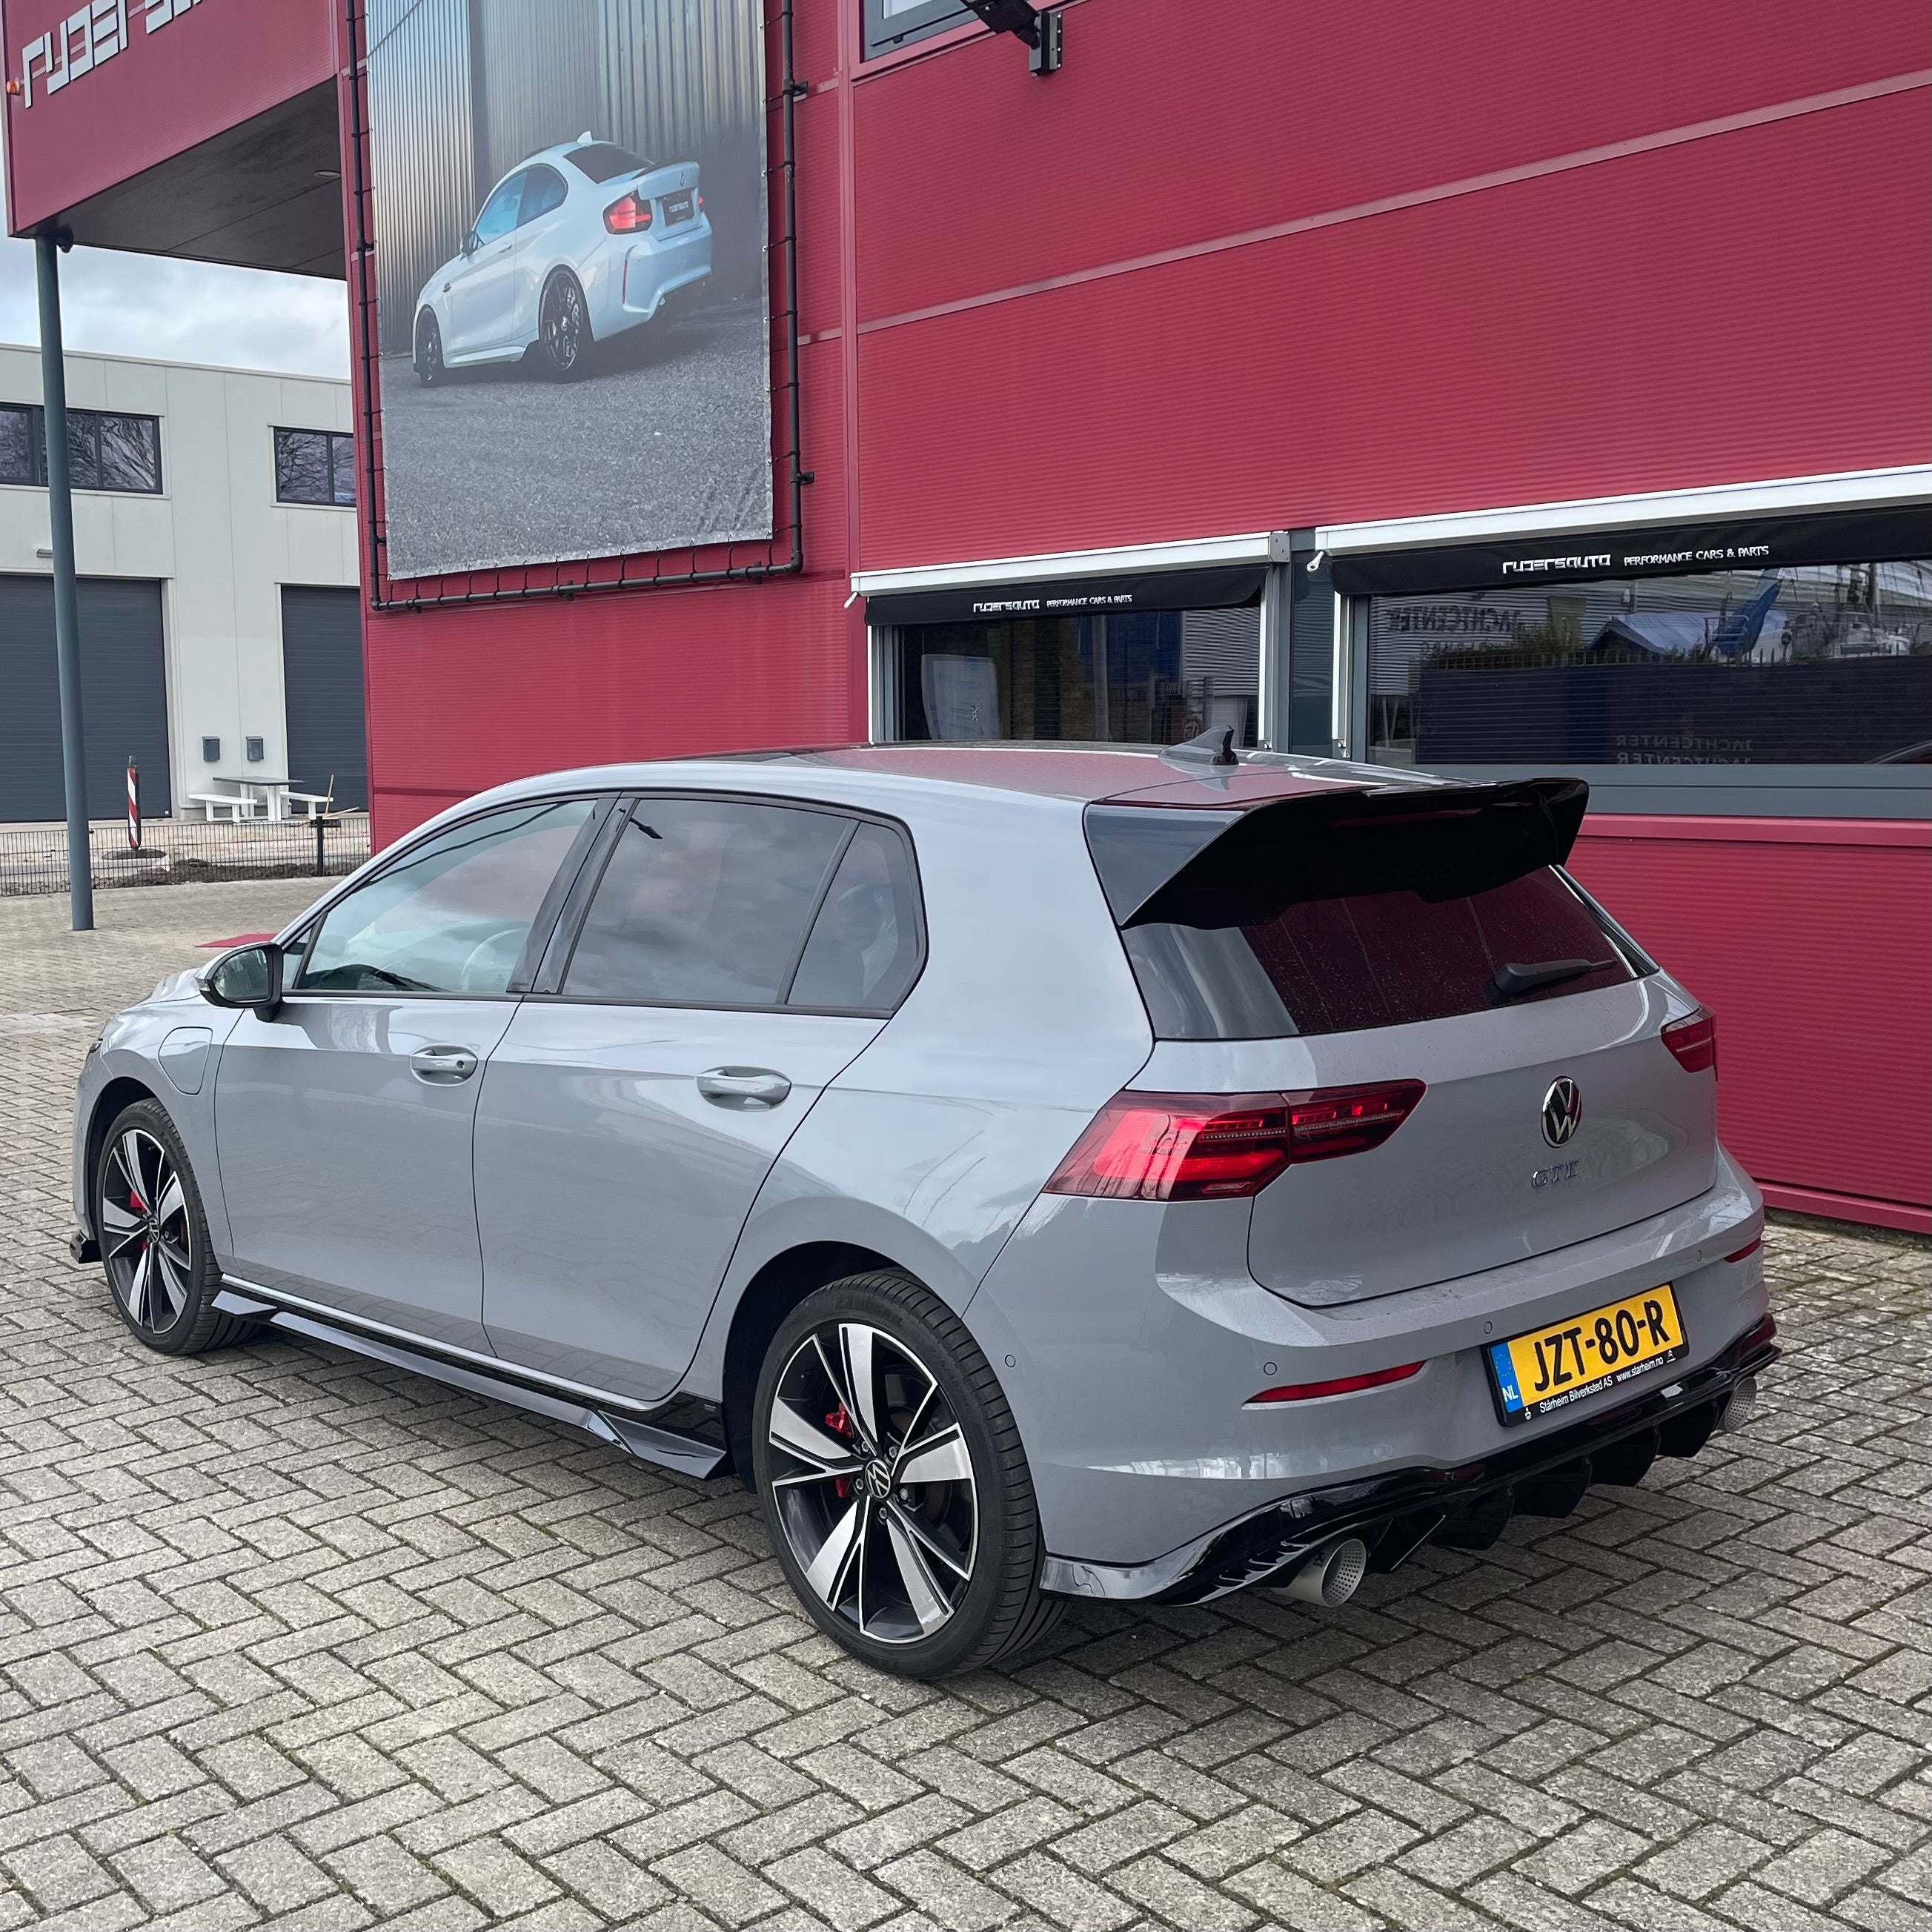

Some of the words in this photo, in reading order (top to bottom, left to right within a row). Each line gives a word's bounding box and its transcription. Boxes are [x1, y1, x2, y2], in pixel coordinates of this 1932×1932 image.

[1624, 552, 1693, 567] PERFORMANCE
[1696, 549, 1724, 560] CARS
[1727, 548, 1736, 557] &
[1738, 545, 1769, 557] PARTS
[1046, 597, 1088, 608] PERFORMANCE
[1089, 596, 1106, 605] CARS
[1114, 594, 1132, 603] PARTS
[1531, 1160, 1579, 1189] GTE
[1534, 1300, 1670, 1392] JZT-80-R
[1502, 1384, 1518, 1403] NL
[1569, 1380, 1603, 1401] Bilverksted
[1603, 1375, 1613, 1392] AS
